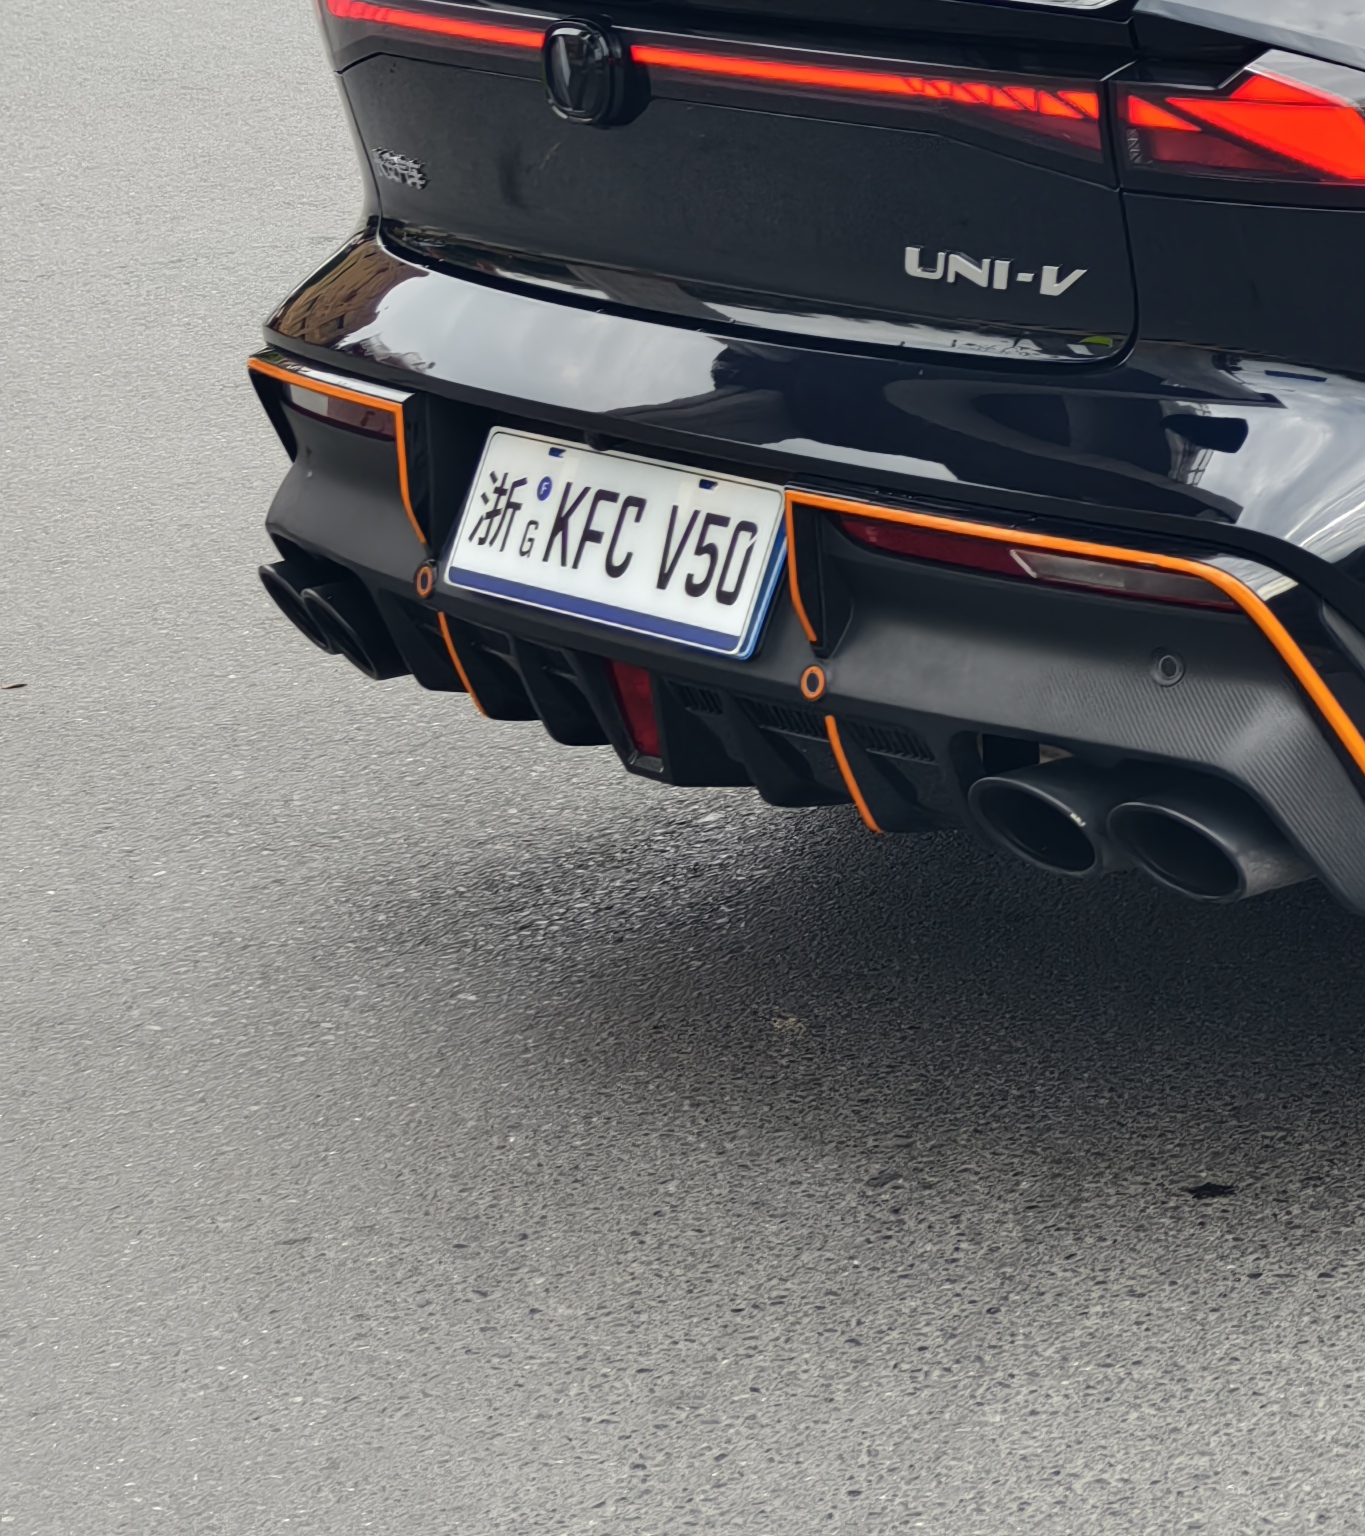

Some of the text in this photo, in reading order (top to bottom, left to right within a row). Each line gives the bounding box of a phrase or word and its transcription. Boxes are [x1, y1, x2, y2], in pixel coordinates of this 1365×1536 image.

[904, 246, 1089, 297] UNI-V
[468, 470, 759, 607] 浙 G KFC V50
